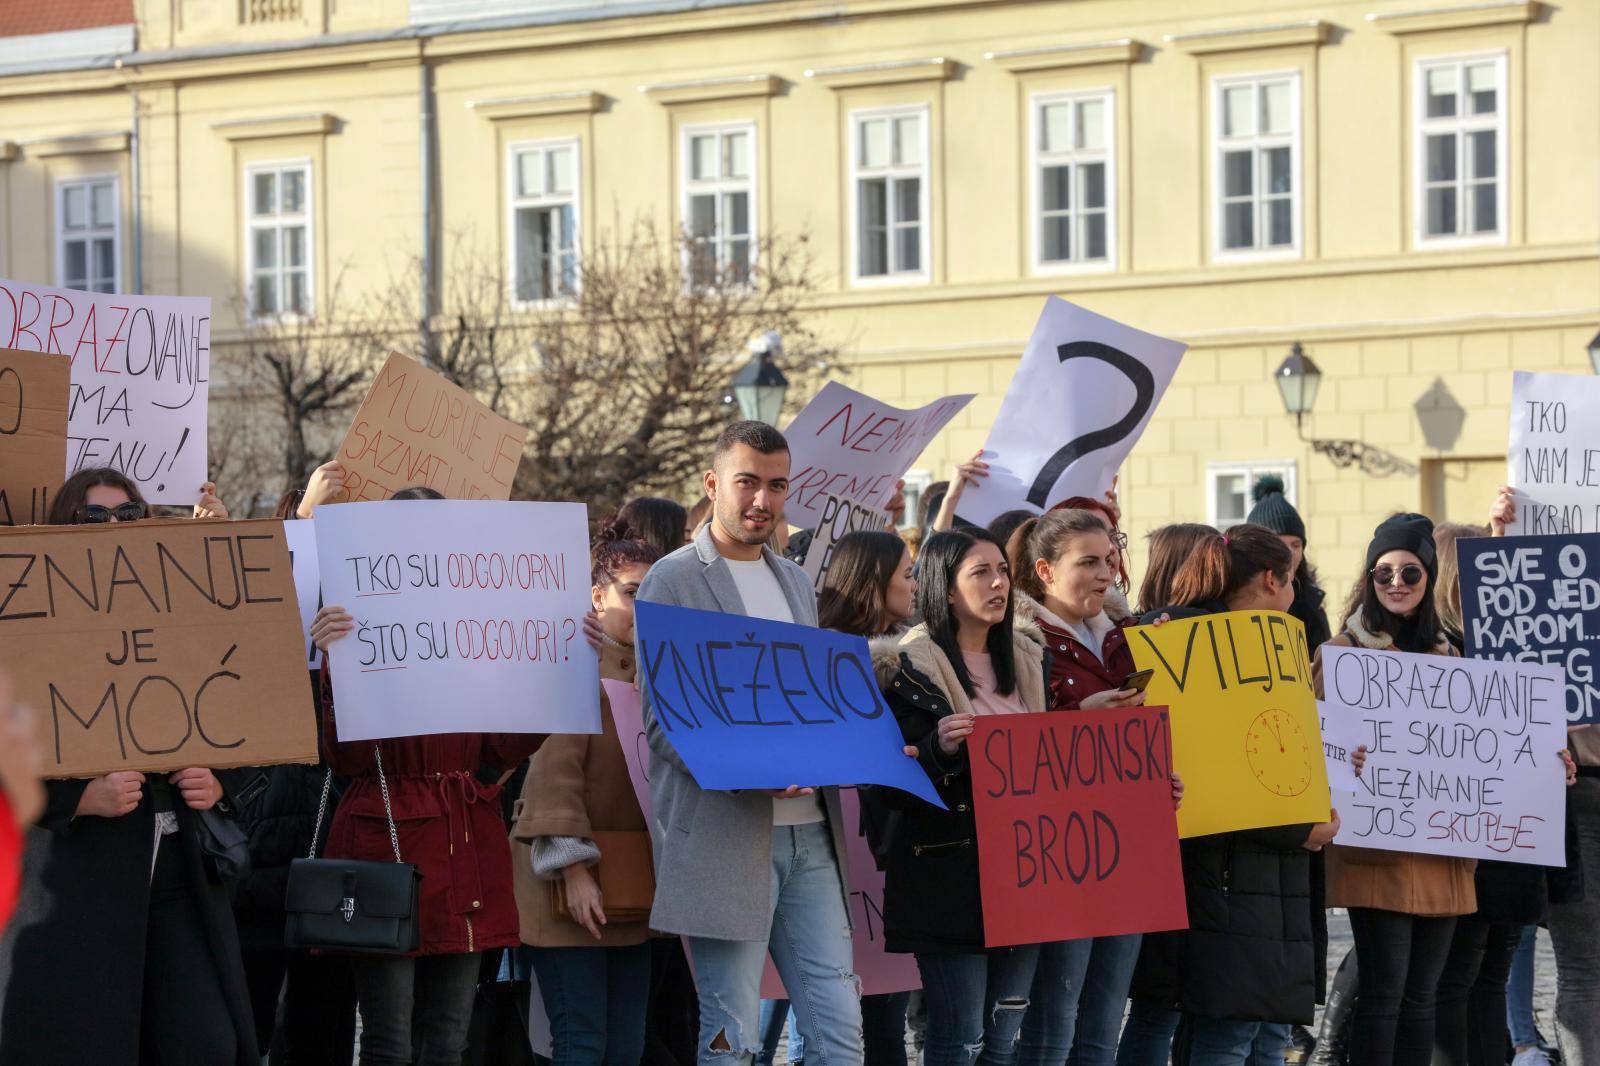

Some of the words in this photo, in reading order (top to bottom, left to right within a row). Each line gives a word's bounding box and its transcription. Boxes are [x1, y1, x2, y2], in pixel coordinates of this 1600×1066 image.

[1526, 400, 1567, 434] TKO
[482, 433, 523, 488] JE
[1525, 447, 1568, 484] NAM
[1575, 448, 1600, 487] JE
[0, 536, 284, 621] ZNANJE
[346, 554, 402, 592] TKO
[408, 554, 439, 589] SU
[447, 553, 566, 592] ODGOVORNI
[1474, 548, 1546, 586] SVE
[1558, 544, 1587, 578] O
[1477, 583, 1537, 618] POD
[105, 629, 158, 666] JE
[357, 620, 408, 666] ŠTO
[415, 621, 448, 661] SU
[455, 618, 577, 663] ODGOVORI?
[48, 644, 246, 764] MOĆ
[641, 632, 884, 732] KNEŽEVO
[1335, 652, 1555, 737] OBRAZOVANJE
[1363, 719, 1397, 754] JE
[1514, 734, 1537, 768] A
[1012, 809, 1121, 889] BROD
[1352, 801, 1417, 838] JOŠ
[1426, 810, 1546, 853] SKUPLJE
